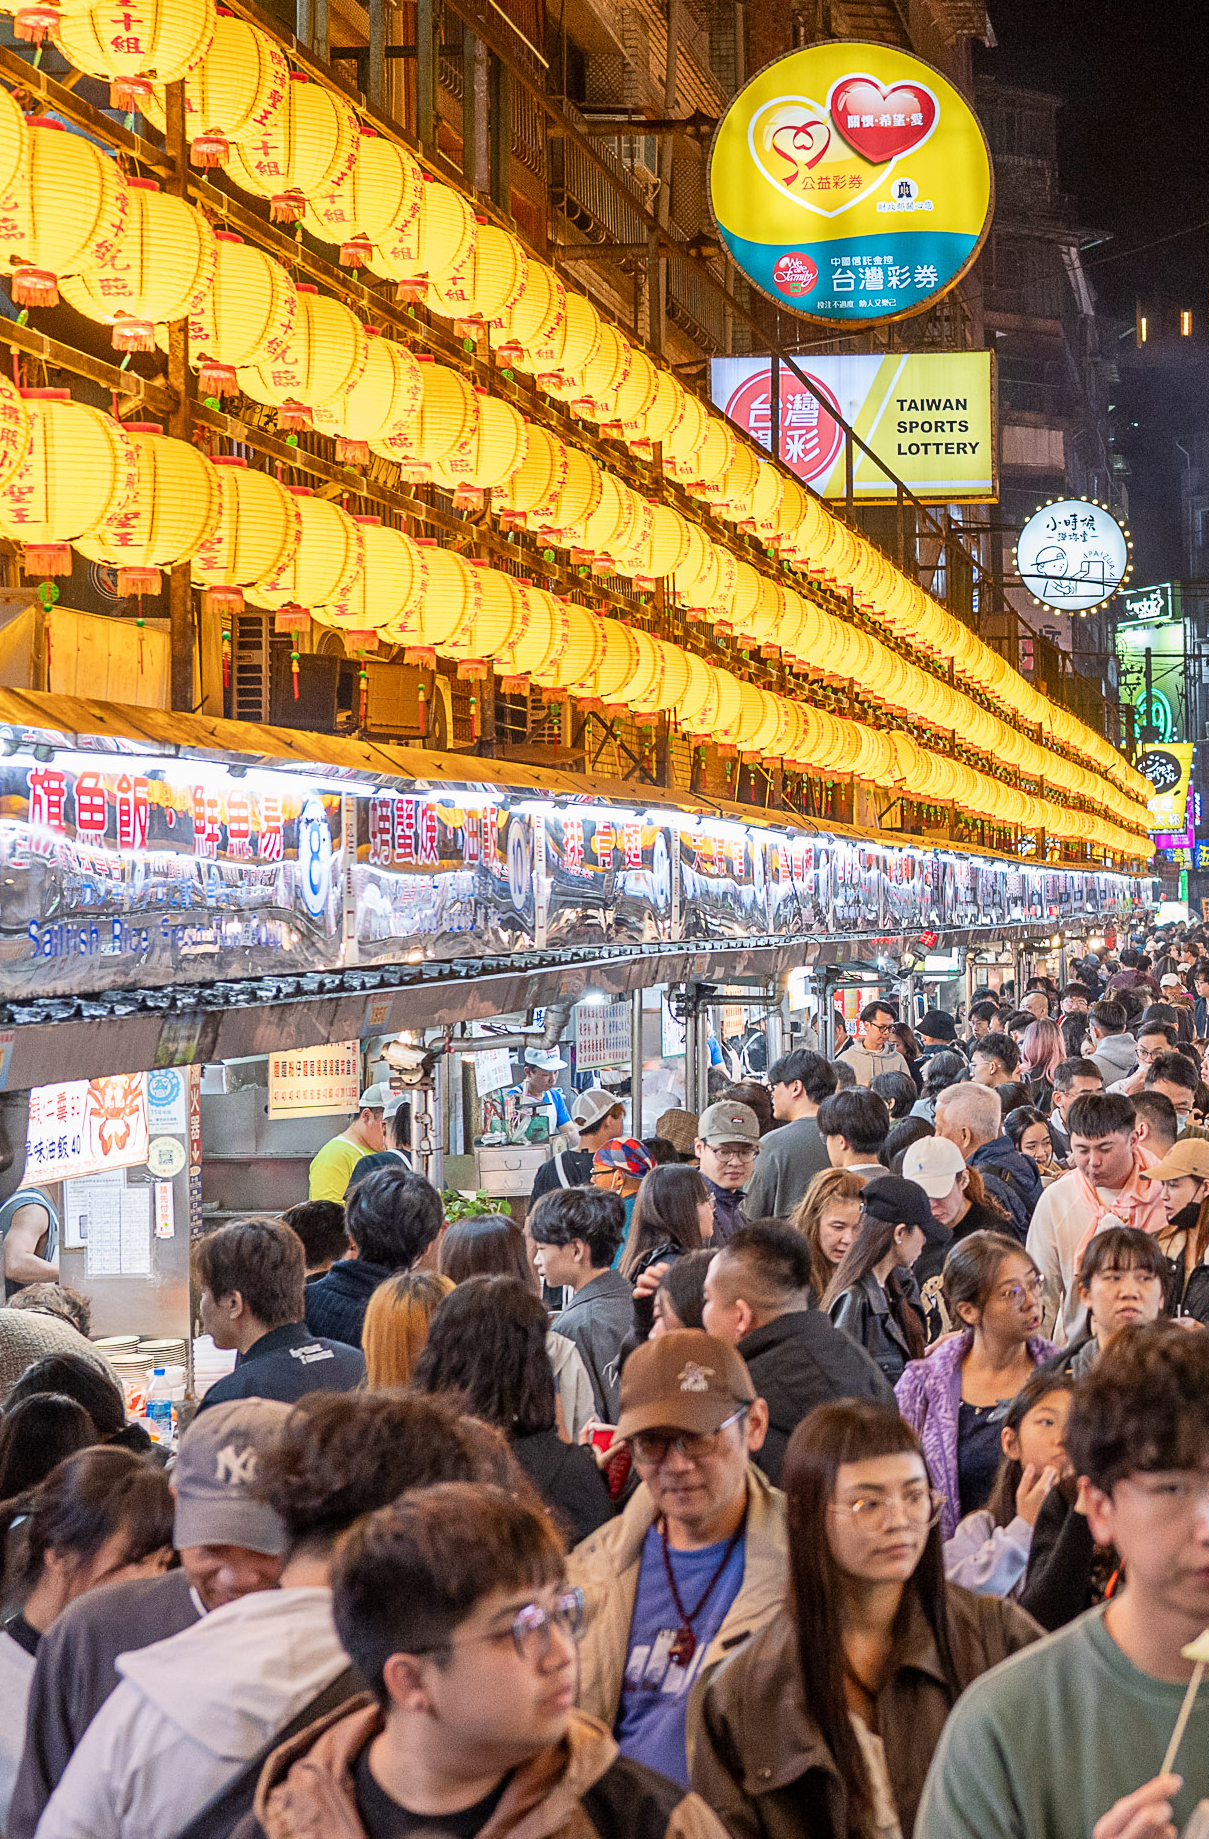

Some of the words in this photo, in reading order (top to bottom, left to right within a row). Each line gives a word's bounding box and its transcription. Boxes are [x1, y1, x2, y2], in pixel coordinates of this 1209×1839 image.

[802, 175, 863, 190] 公益彩券
[787, 258, 803, 267] We
[831, 256, 893, 266] 中國信託金控
[832, 265, 938, 291] 台灣彩券
[897, 398, 968, 412] TAIWAN
[897, 420, 969, 433] SPORTS
[897, 441, 979, 456] LOTTERY
[1046, 513, 1096, 531] 小時候
[1154, 813, 1181, 826] 大杯
[309, 822, 321, 896] 8
[512, 838, 524, 895] 10
[71, 1134, 81, 1155] 40
[215, 1444, 258, 1485] NY
